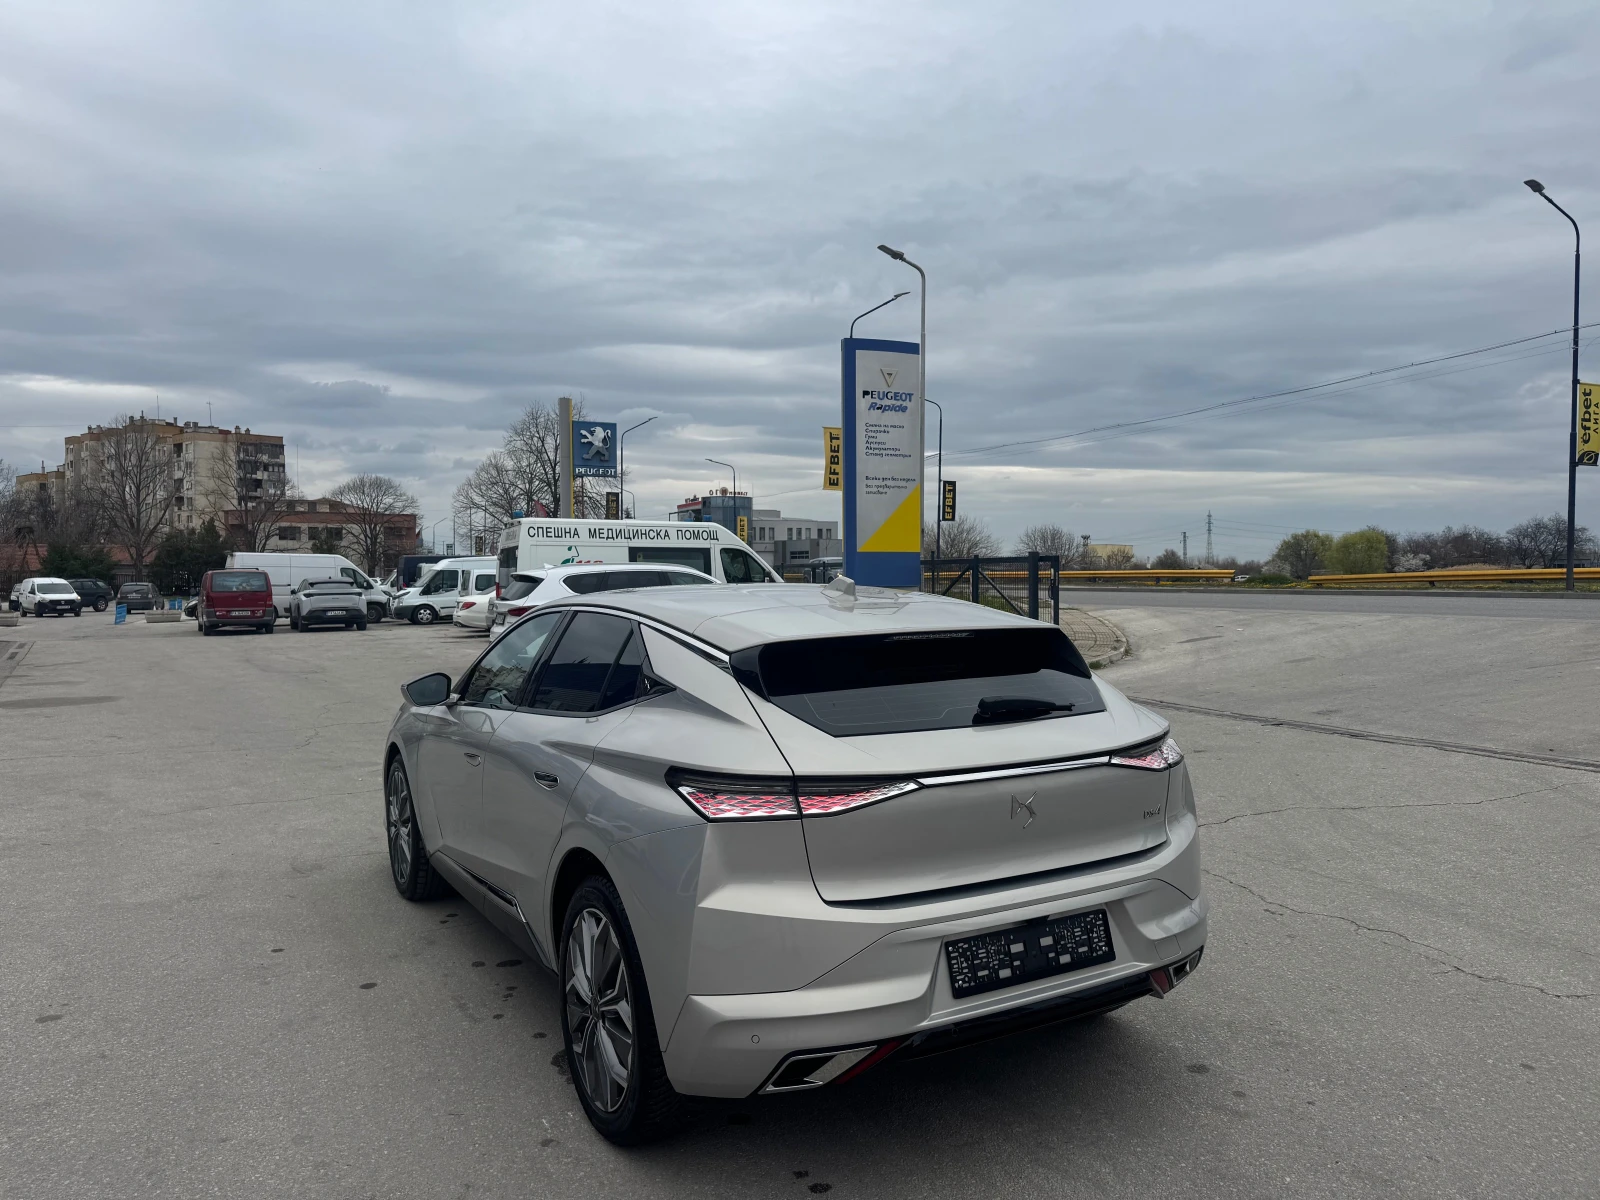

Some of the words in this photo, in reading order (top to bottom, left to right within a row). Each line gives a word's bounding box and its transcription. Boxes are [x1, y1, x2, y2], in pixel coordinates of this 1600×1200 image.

[862, 390, 914, 402] PEUGEOT
[868, 402, 908, 413] Rapide
[1581, 388, 1593, 445] efbet
[828, 432, 840, 487] EFBET
[575, 467, 616, 476] PEUGEOT
[945, 484, 953, 519] EFBET
[527, 526, 580, 539] СПЕШНА
[588, 527, 671, 541] МЕДИЦИНСКА
[676, 529, 720, 542] ПОМОЩ
